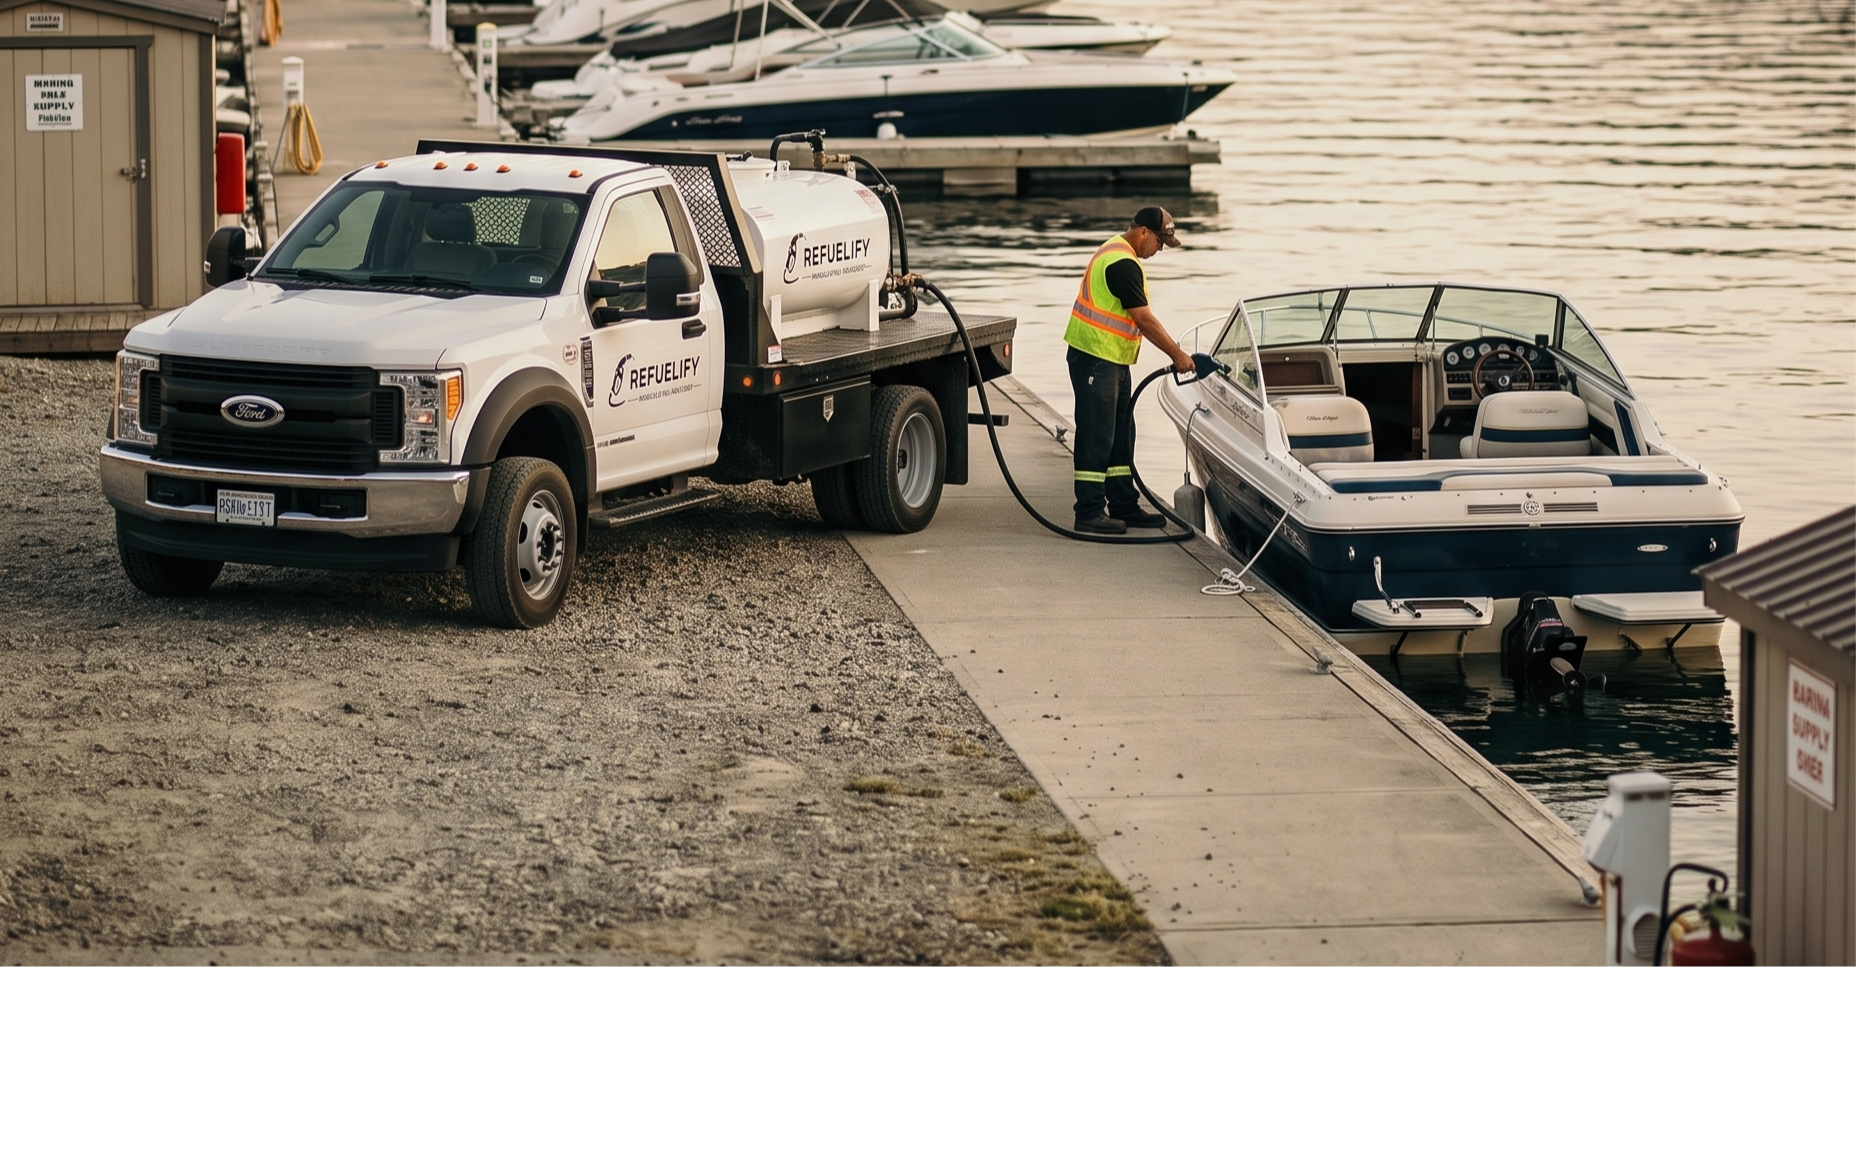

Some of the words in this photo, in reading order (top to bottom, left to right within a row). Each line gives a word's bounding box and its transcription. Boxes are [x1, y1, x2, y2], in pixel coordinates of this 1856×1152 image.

[804, 238, 870, 267] REFUELIFY
[630, 356, 700, 390] REFUELIFY
[235, 402, 266, 420] Ford
[1792, 712, 1830, 753] SUPPLY
